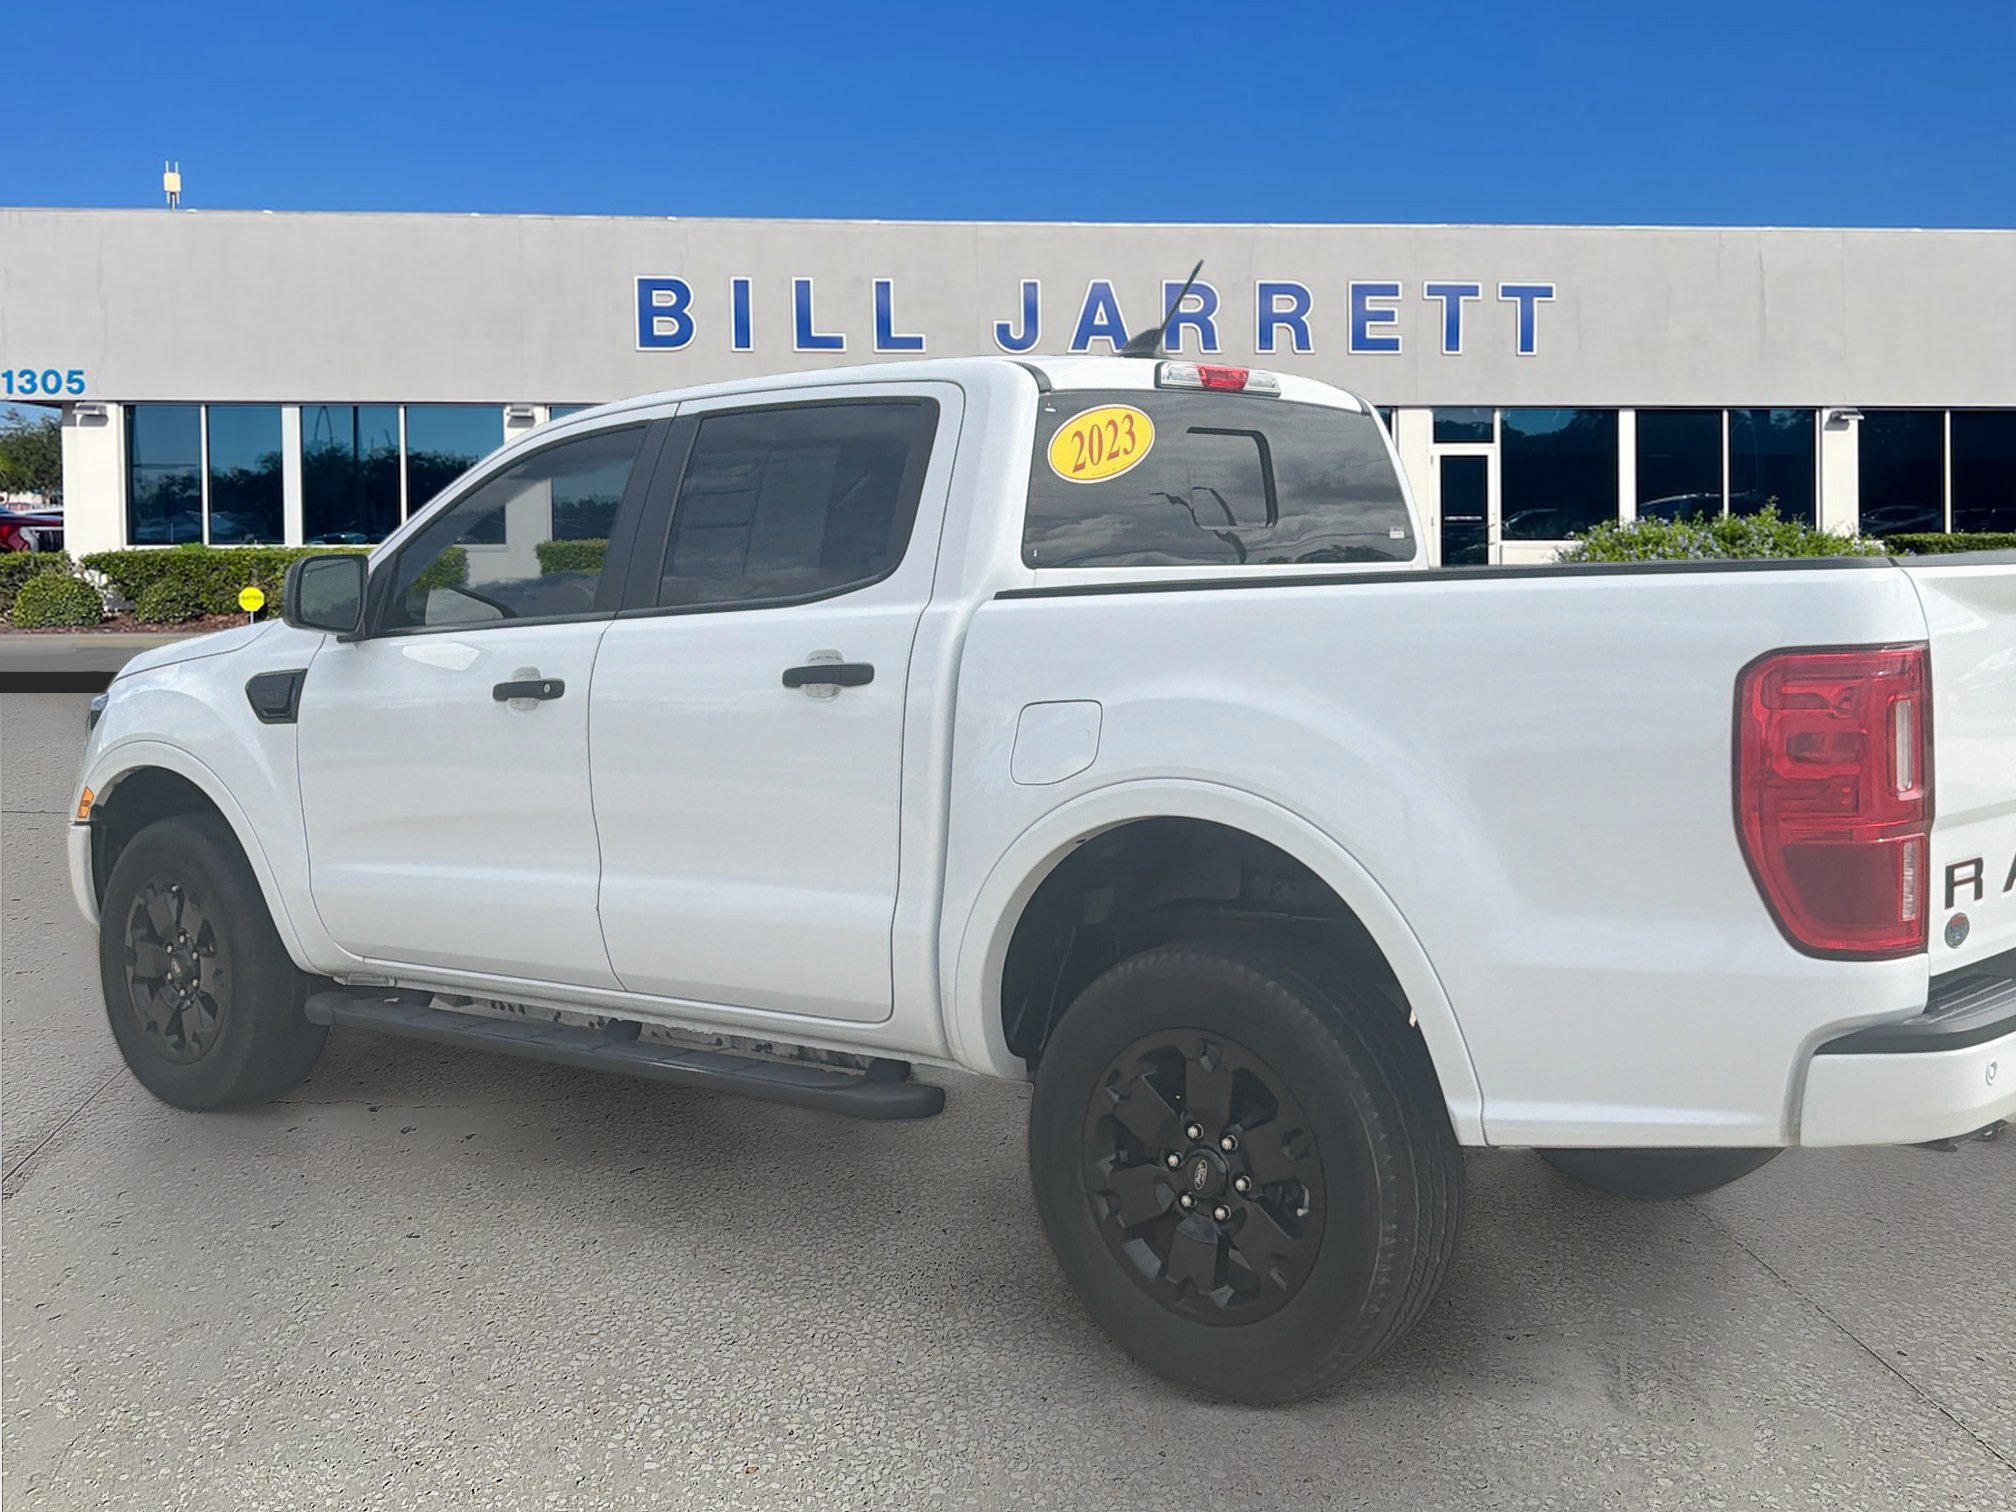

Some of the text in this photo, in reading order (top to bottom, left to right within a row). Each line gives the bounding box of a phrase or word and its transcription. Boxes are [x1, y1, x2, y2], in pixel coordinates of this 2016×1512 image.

[634, 275, 1556, 355] BILL JARRETT
[1, 368, 86, 395] 1305
[1070, 413, 1136, 474] 2023
